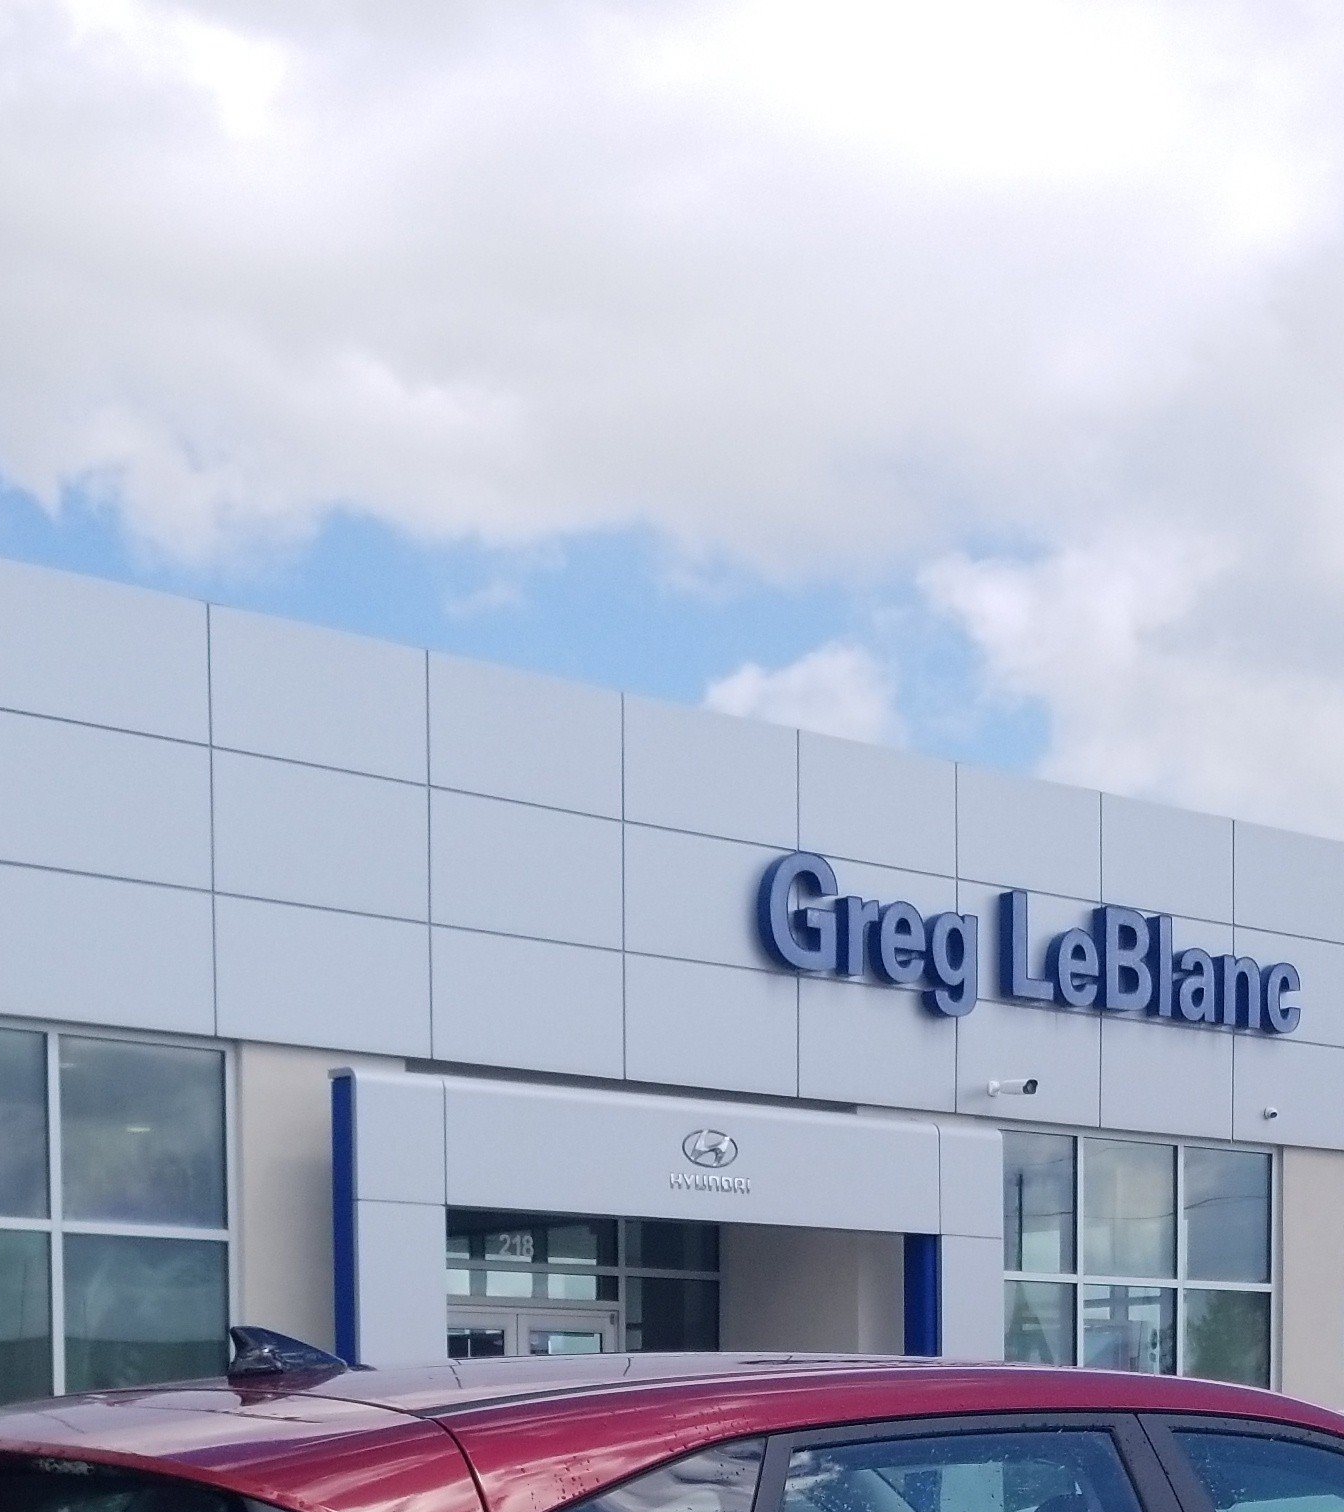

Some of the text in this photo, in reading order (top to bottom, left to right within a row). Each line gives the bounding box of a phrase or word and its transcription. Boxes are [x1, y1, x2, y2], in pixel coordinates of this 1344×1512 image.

[757, 849, 1302, 1035] Greg LeBlanc
[669, 1172, 751, 1195] HYUNDAI
[499, 1233, 535, 1258] 218
